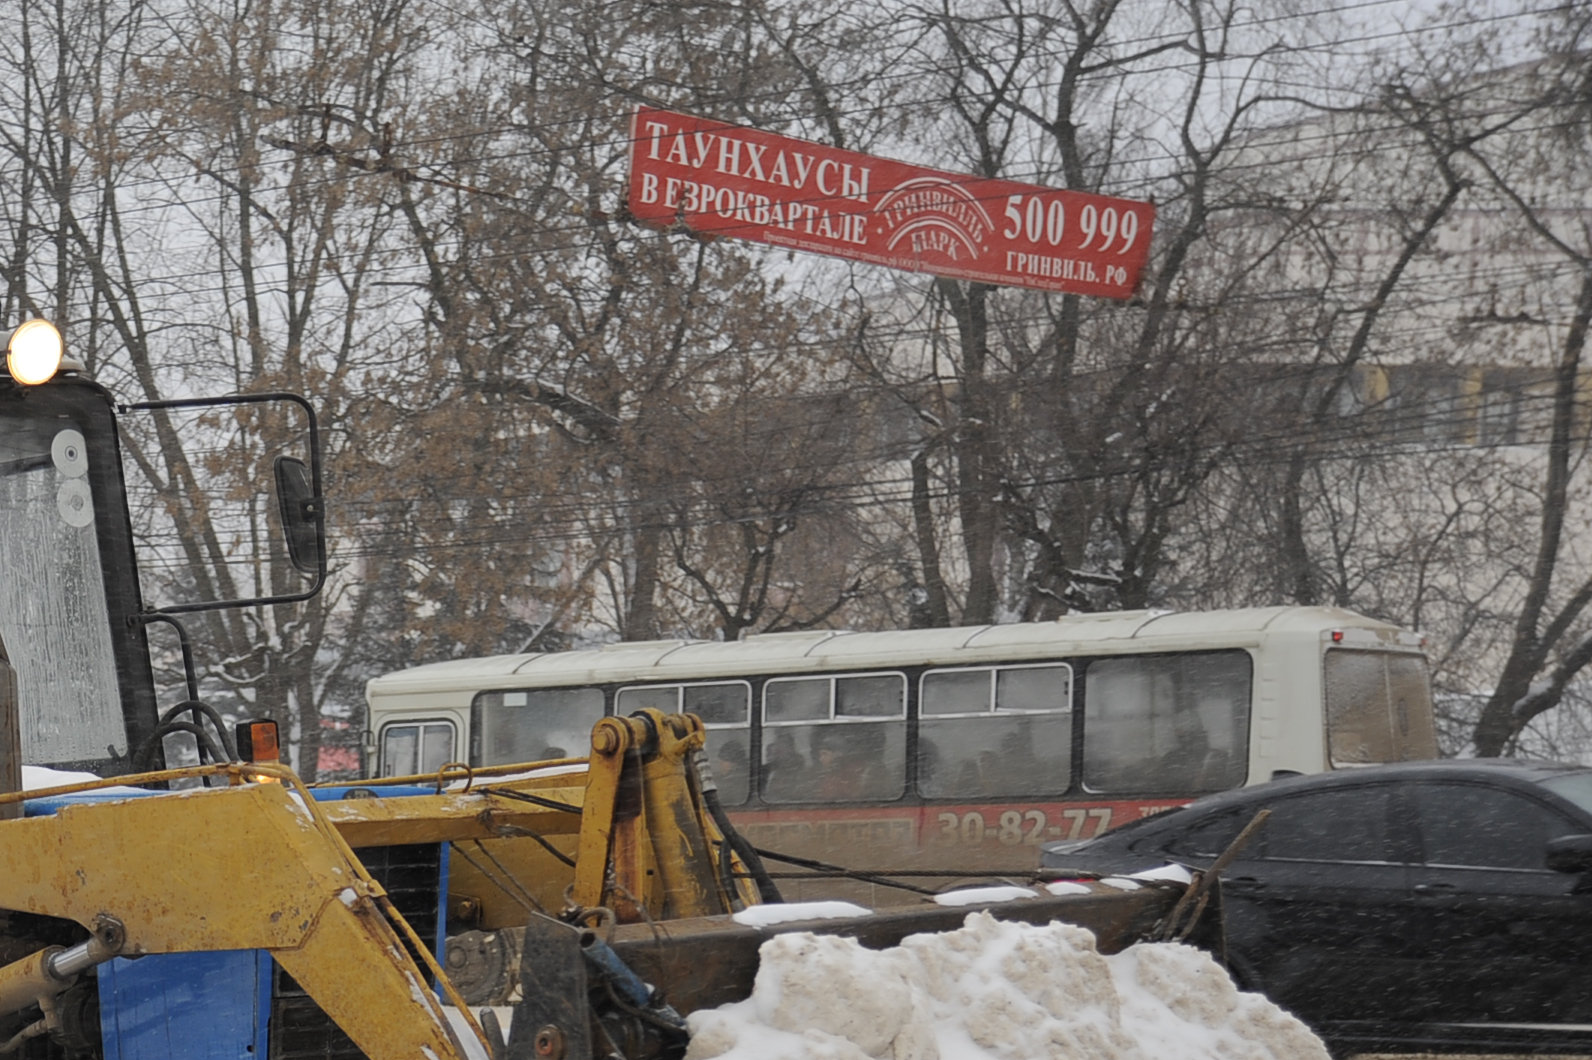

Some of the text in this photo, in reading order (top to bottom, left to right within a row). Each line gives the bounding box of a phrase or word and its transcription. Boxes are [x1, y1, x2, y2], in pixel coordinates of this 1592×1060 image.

[645, 120, 871, 203] ТАУНХАУСЫ
[639, 173, 659, 205] В
[1003, 194, 1139, 256] 500 999
[910, 229, 961, 261] ПАРК
[1104, 265, 1127, 287] РФ
[937, 807, 1113, 848] 30-82-77
